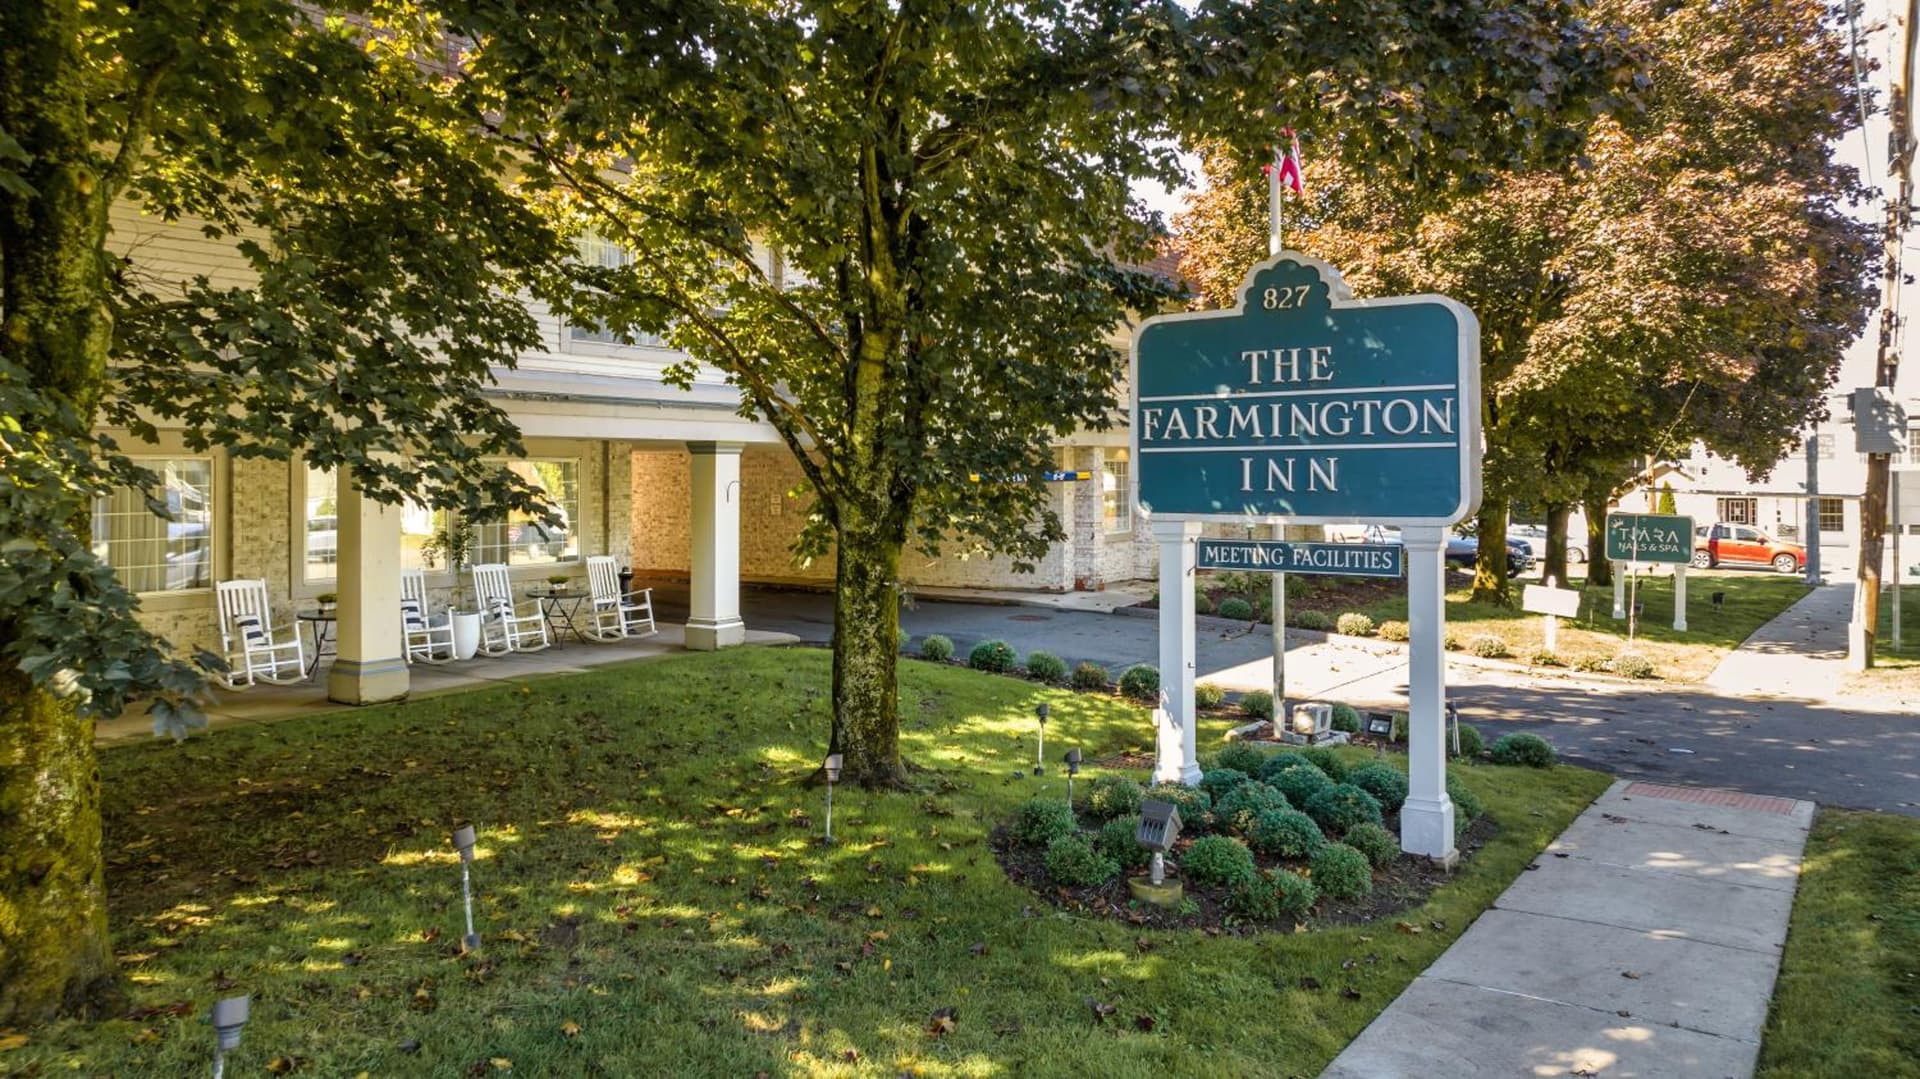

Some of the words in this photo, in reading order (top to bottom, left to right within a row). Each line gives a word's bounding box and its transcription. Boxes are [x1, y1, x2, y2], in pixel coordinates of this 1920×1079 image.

[1263, 285, 1311, 310] 827
[1241, 346, 1334, 384] THE
[1142, 397, 1455, 441] FARMINGTON
[1239, 457, 1338, 492] INN
[1205, 546, 1284, 565] MEETING
[1293, 549, 1393, 569] FACILITIES
[1649, 544, 1657, 552] &
[1659, 544, 1679, 552] SPA
